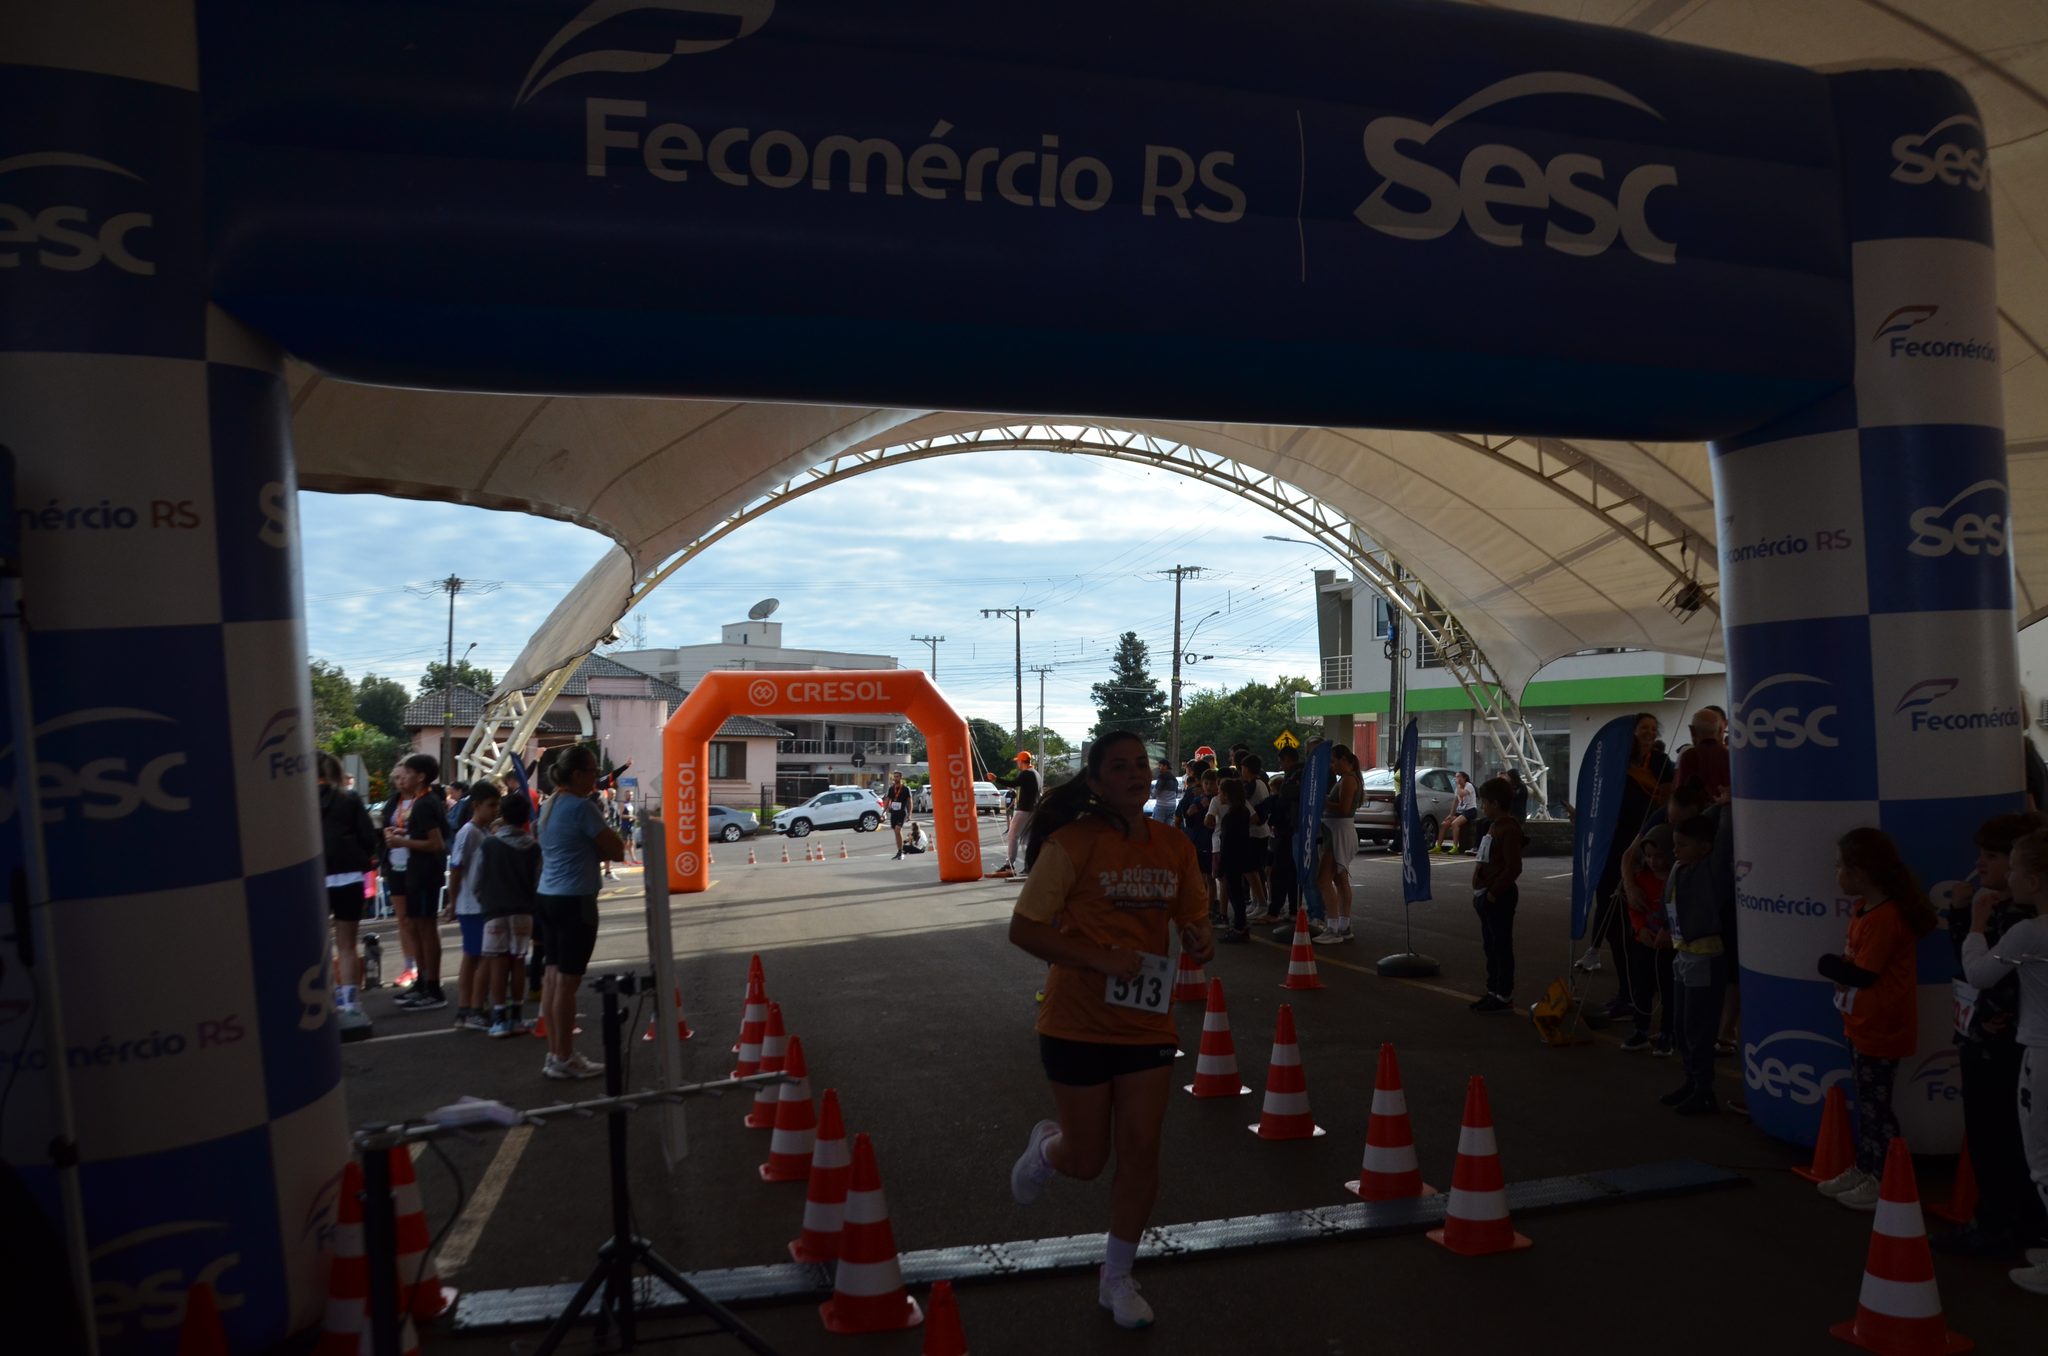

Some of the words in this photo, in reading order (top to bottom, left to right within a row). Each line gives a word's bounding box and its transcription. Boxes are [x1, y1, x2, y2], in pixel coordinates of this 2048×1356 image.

[584, 97, 1113, 211] Fecomércio
[1141, 144, 1247, 224] RS
[1353, 115, 1679, 264] Sesc
[1889, 133, 1985, 192] Ses
[0, 206, 156, 276] esc
[151, 500, 200, 529] RS
[1816, 528, 1852, 551] RS
[1907, 506, 2006, 557] Ses
[786, 681, 891, 703] CRESOL
[0, 751, 192, 824] esc
[678, 755, 697, 846] CRESOL
[949, 746, 970, 833] CRESOL
[1113, 975, 1162, 1007] 513
[197, 1014, 245, 1048] RS
